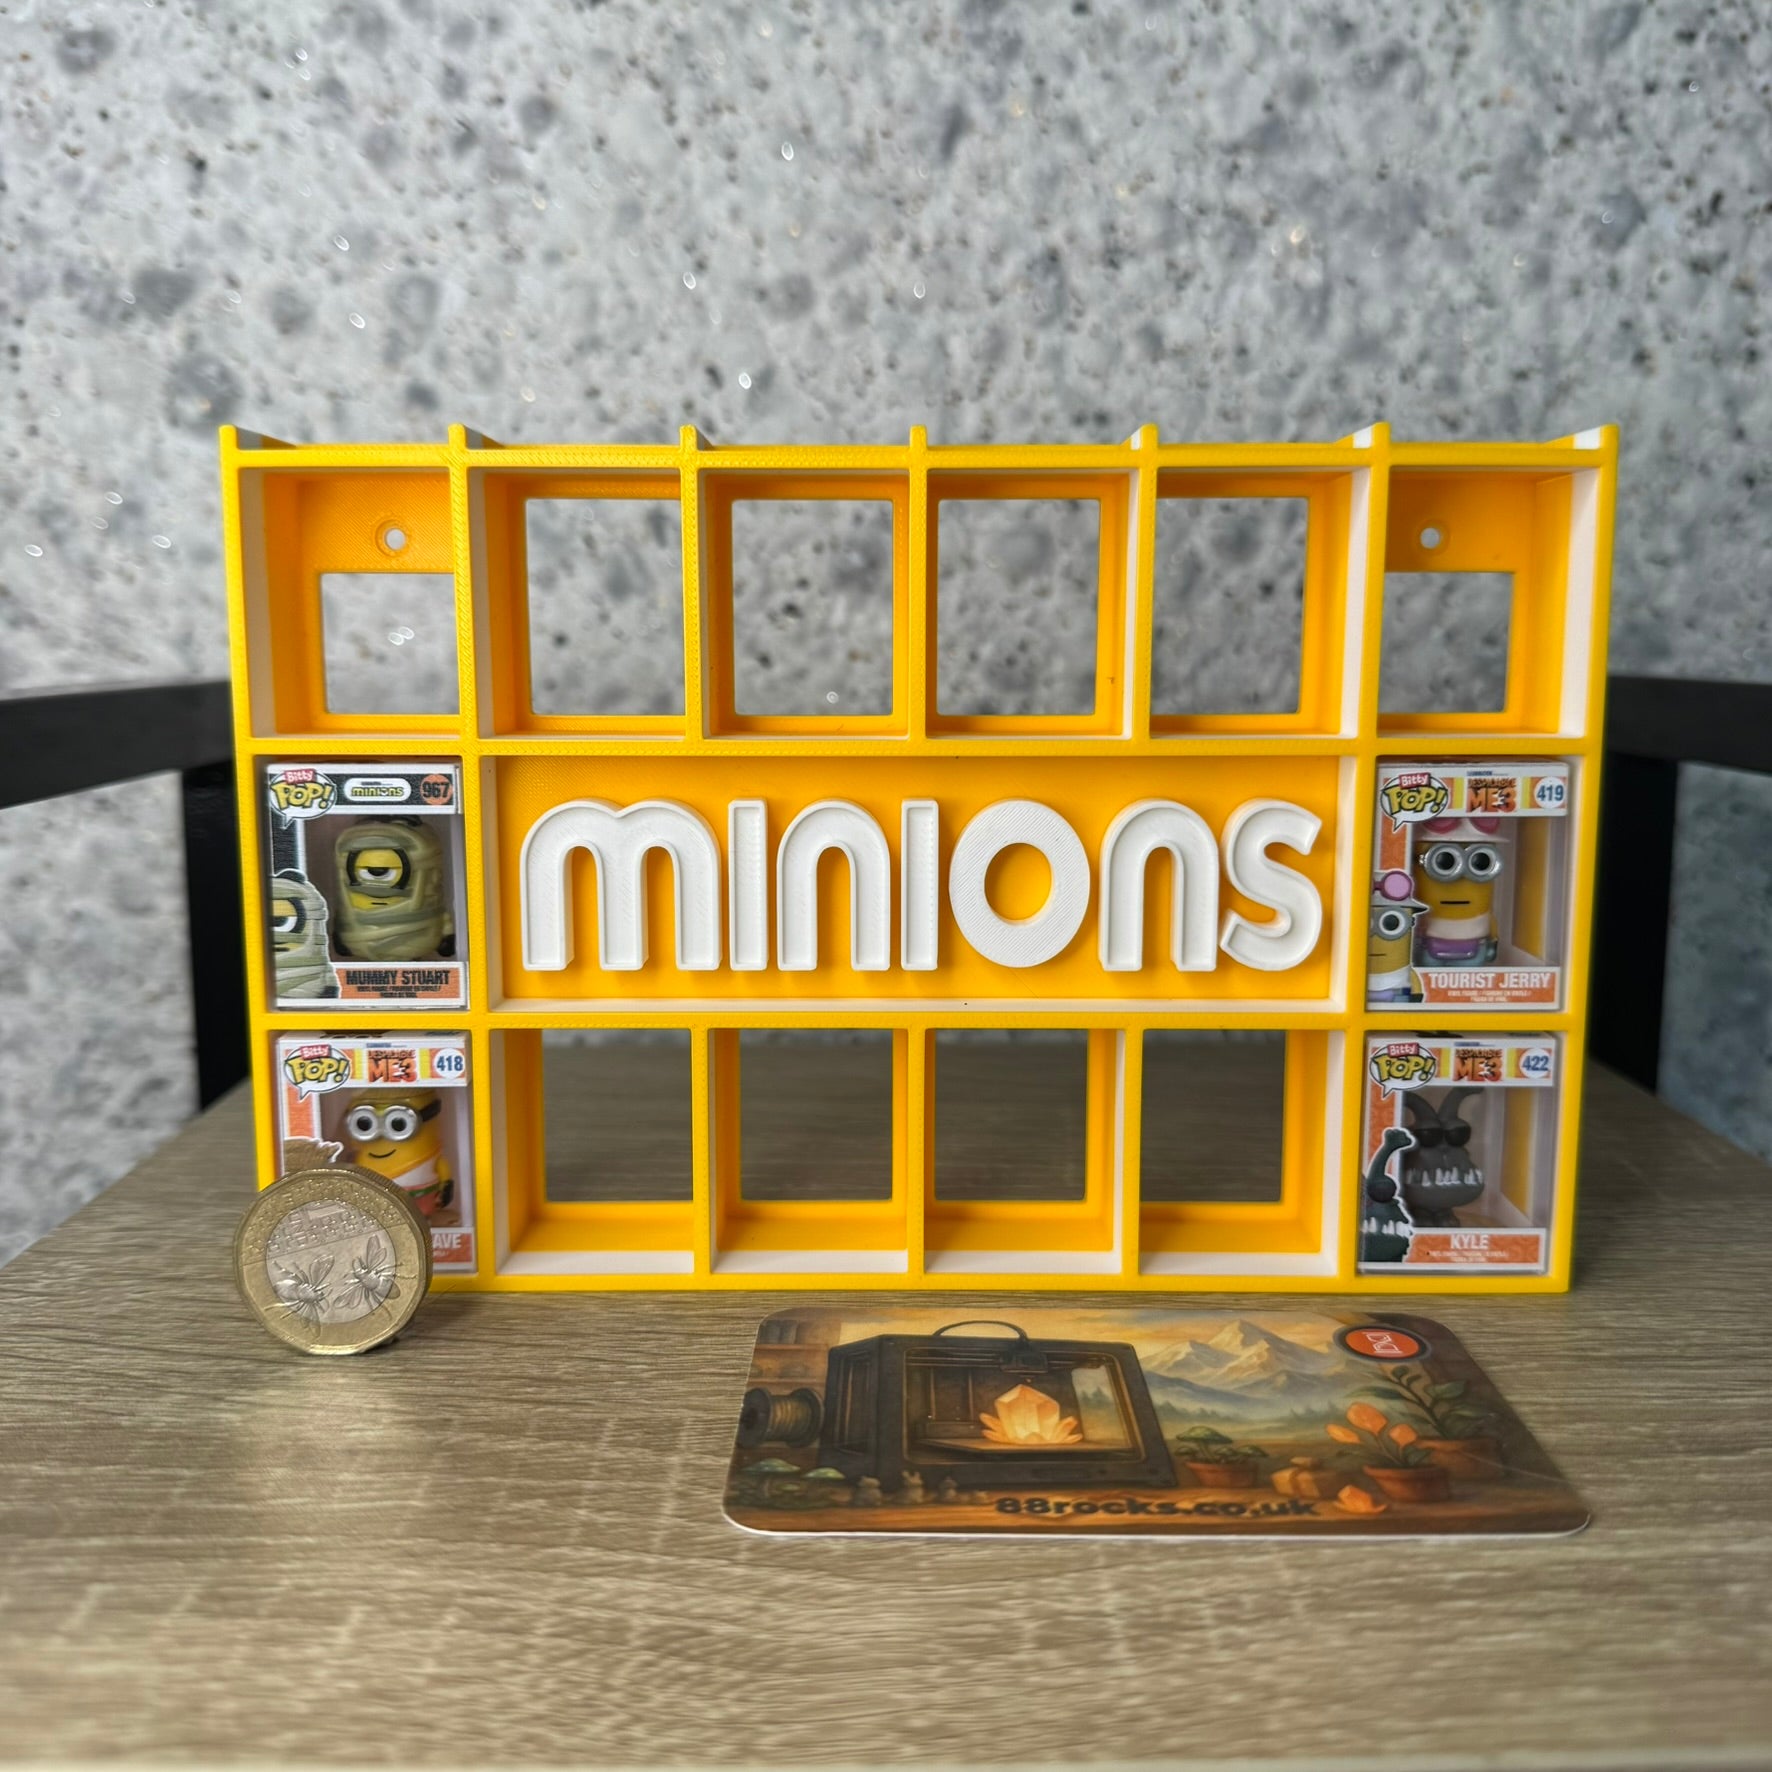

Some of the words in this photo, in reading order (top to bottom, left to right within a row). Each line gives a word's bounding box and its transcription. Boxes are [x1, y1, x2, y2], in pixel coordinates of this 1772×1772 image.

[286, 770, 315, 783] Bitty
[1400, 774, 1430, 788] Bitty
[271, 781, 333, 810] POP!
[422, 781, 450, 799] 967
[1536, 785, 1564, 802] 419
[1383, 785, 1448, 814] POP!
[346, 970, 398, 985] MUMMY
[402, 970, 450, 985] STUART
[1428, 973, 1496, 988] TOURIST
[1499, 973, 1550, 988] JERRY
[302, 1045, 329, 1059] Bitty
[1389, 1043, 1417, 1056] Bitty
[284, 1057, 349, 1084] POP!
[436, 1055, 464, 1072] 418
[1371, 1054, 1436, 1081] POP!
[1522, 1055, 1550, 1072] 422
[433, 1233, 462, 1249] AVE
[1450, 1234, 1489, 1249] KYLE
[995, 1496, 1319, 1517] 88rocks.co.uk
